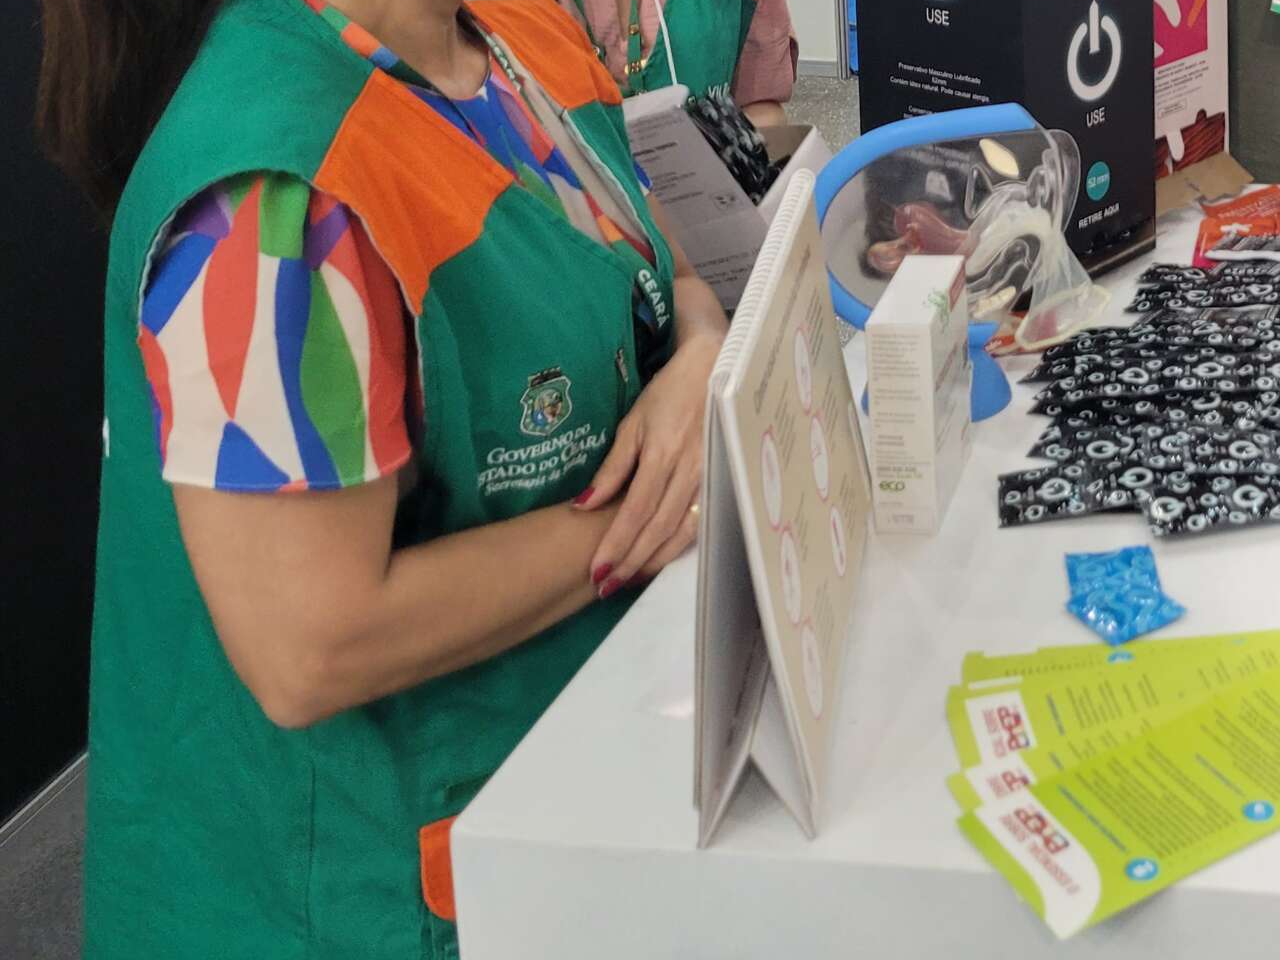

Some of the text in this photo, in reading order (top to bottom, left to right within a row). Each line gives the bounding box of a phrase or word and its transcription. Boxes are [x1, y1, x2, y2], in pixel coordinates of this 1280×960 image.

[926, 7, 950, 26] USE
[1086, 107, 1105, 127] USE
[1079, 202, 1120, 229] RETIRE AQUI
[487, 430, 574, 465] GOVERNO
[539, 455, 560, 472] DO
